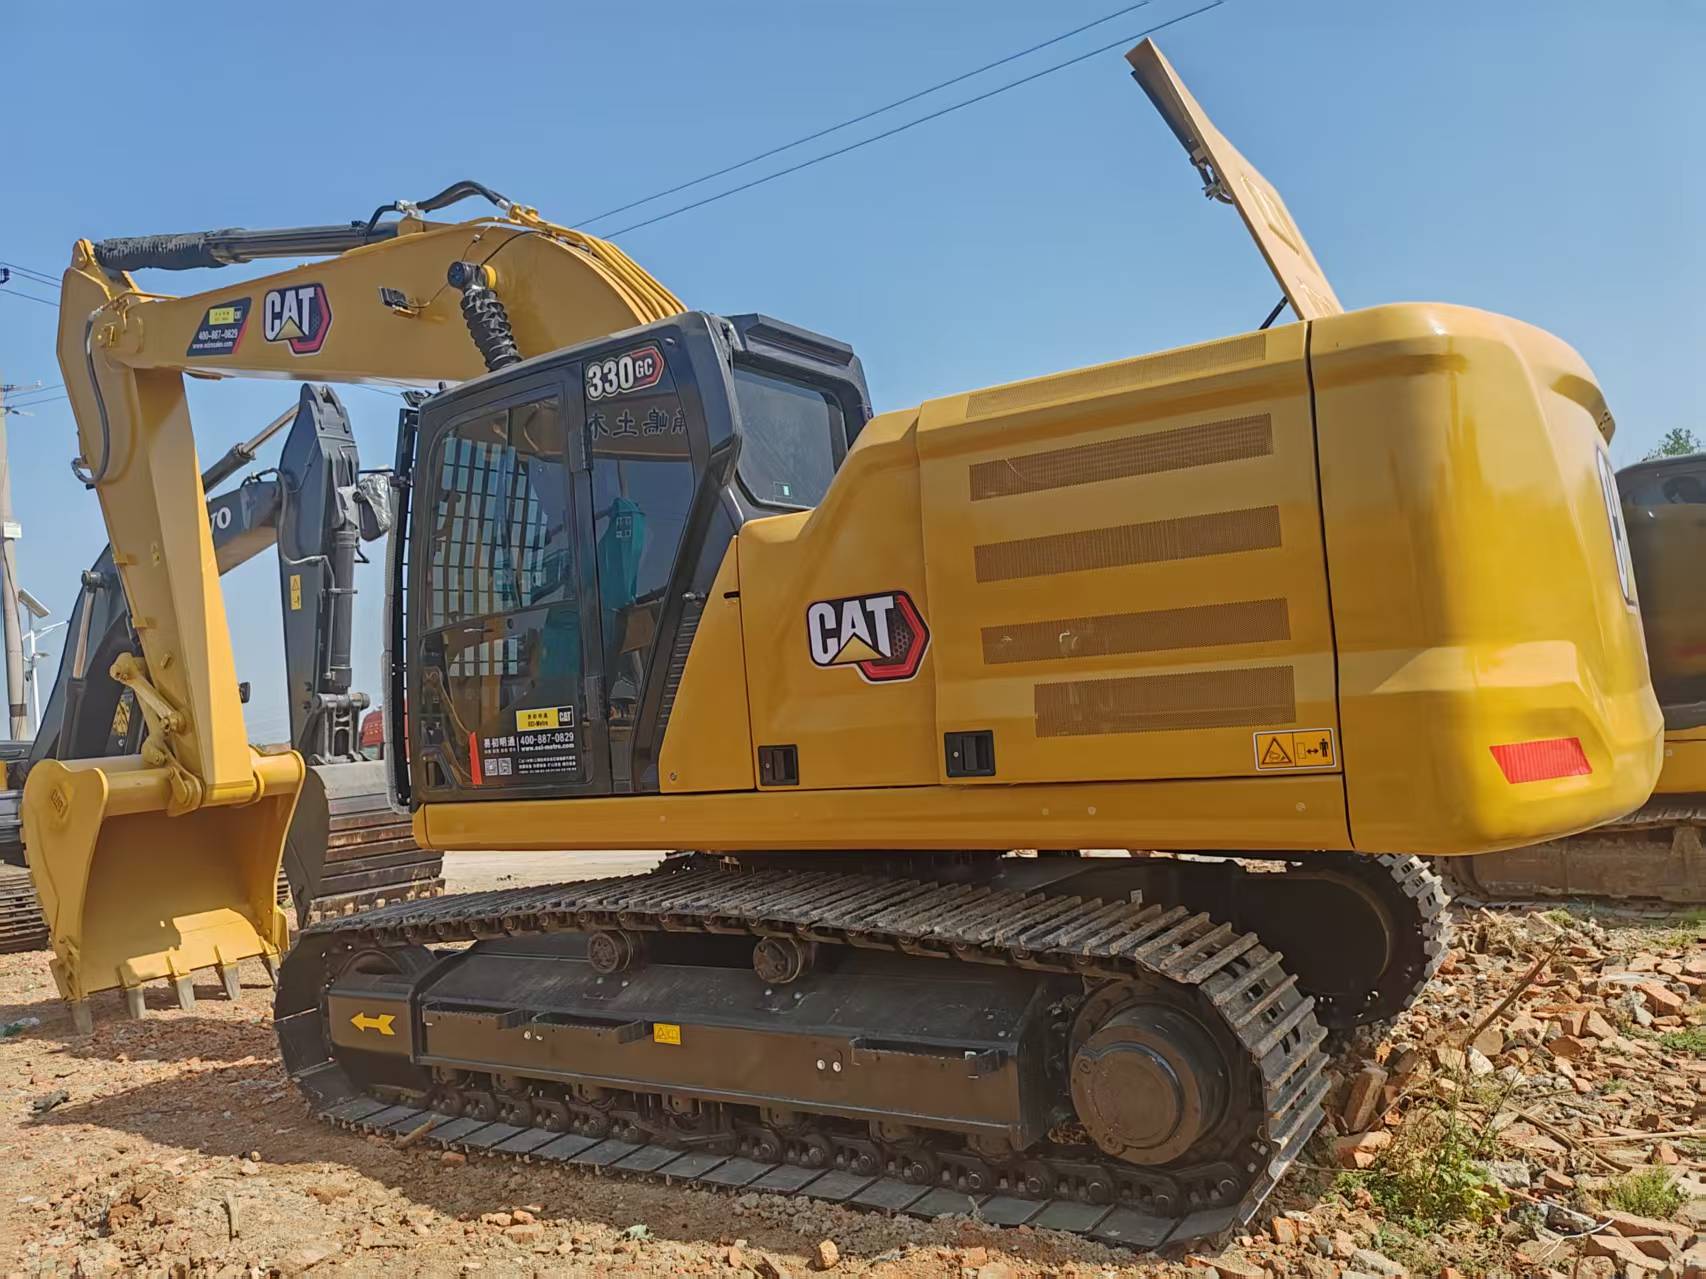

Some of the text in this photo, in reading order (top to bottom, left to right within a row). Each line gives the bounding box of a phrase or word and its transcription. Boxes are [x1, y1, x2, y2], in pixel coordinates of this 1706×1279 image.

[265, 287, 315, 341] CAT
[587, 356, 653, 398] 330 GC
[808, 596, 894, 664] CAT
[520, 732, 574, 745] 400-887-0829
